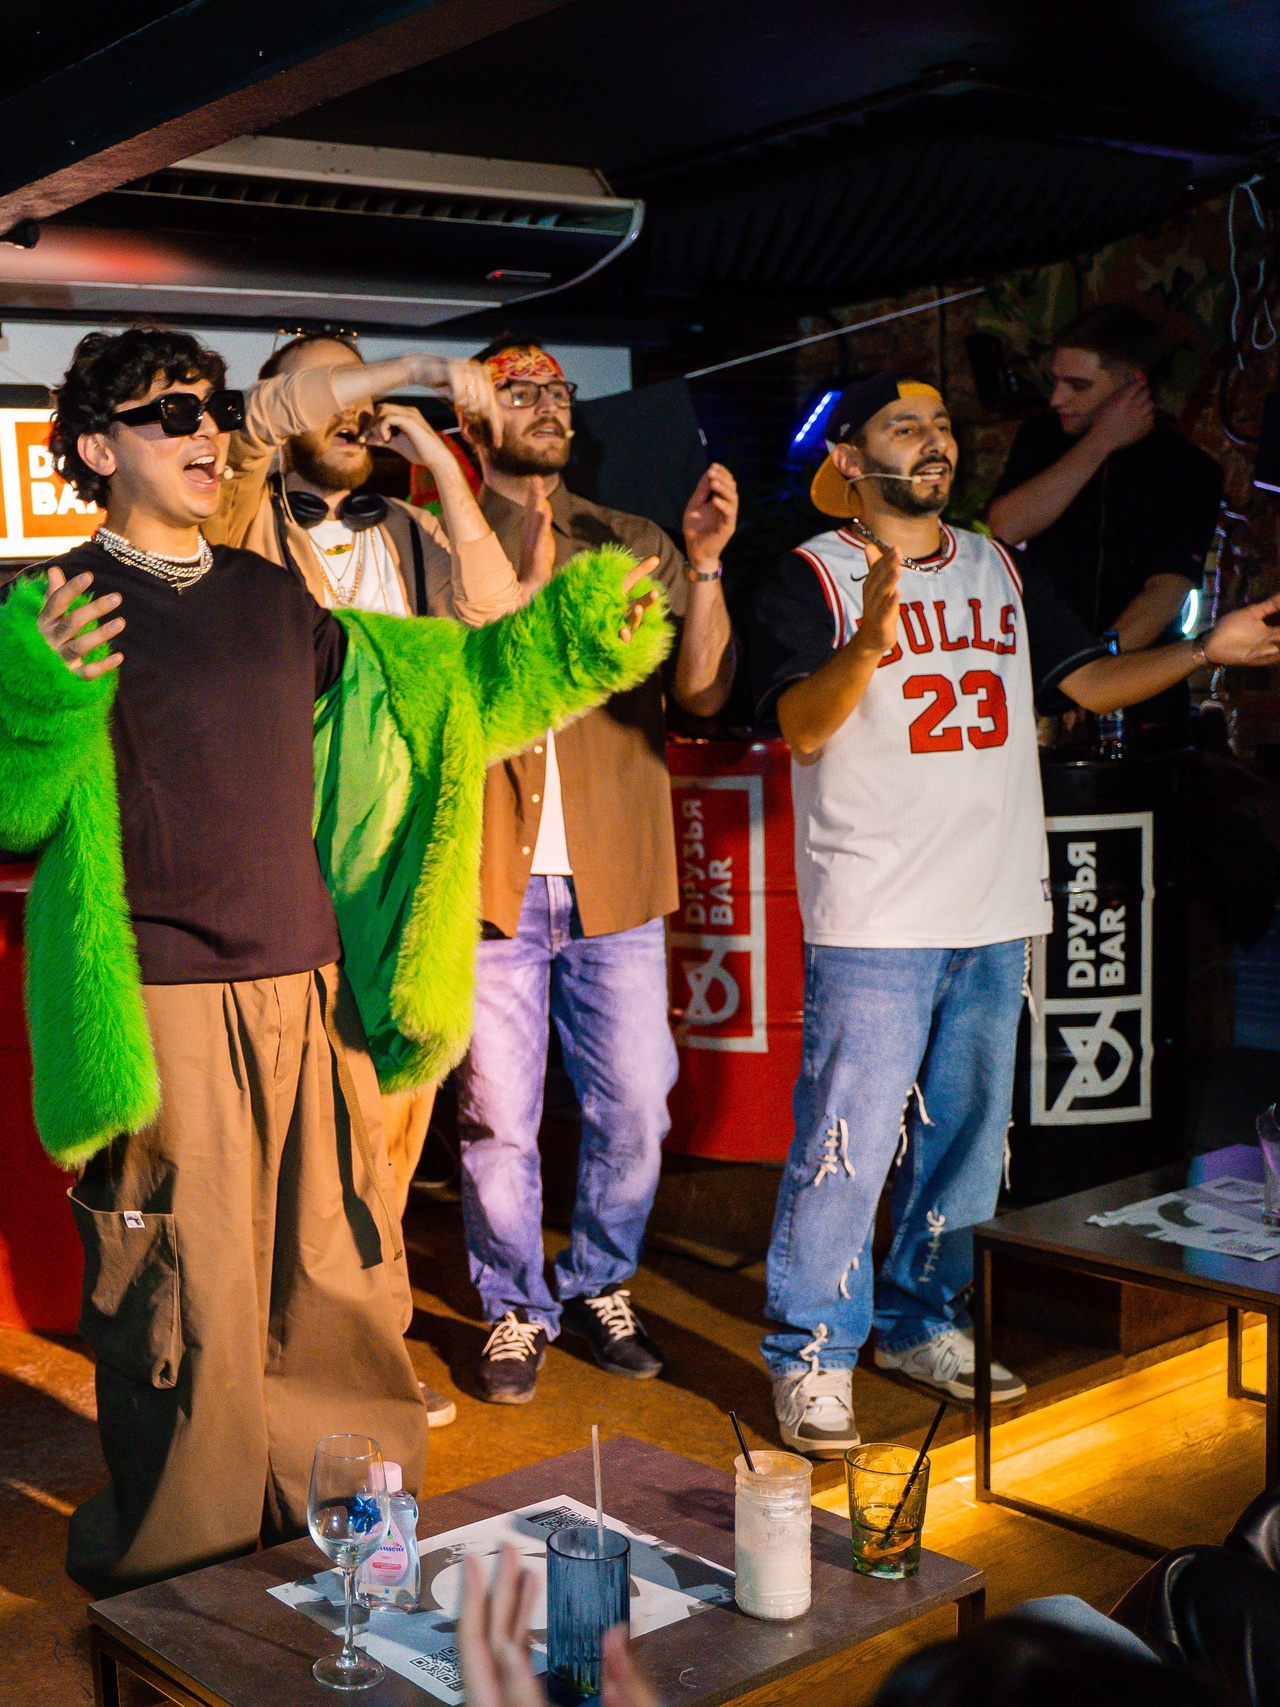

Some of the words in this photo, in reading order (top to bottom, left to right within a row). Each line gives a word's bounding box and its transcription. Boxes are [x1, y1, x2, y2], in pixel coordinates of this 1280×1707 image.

[902, 669, 1009, 754] 23
[708, 856, 734, 926] BAR
[1099, 904, 1126, 987] BAR
